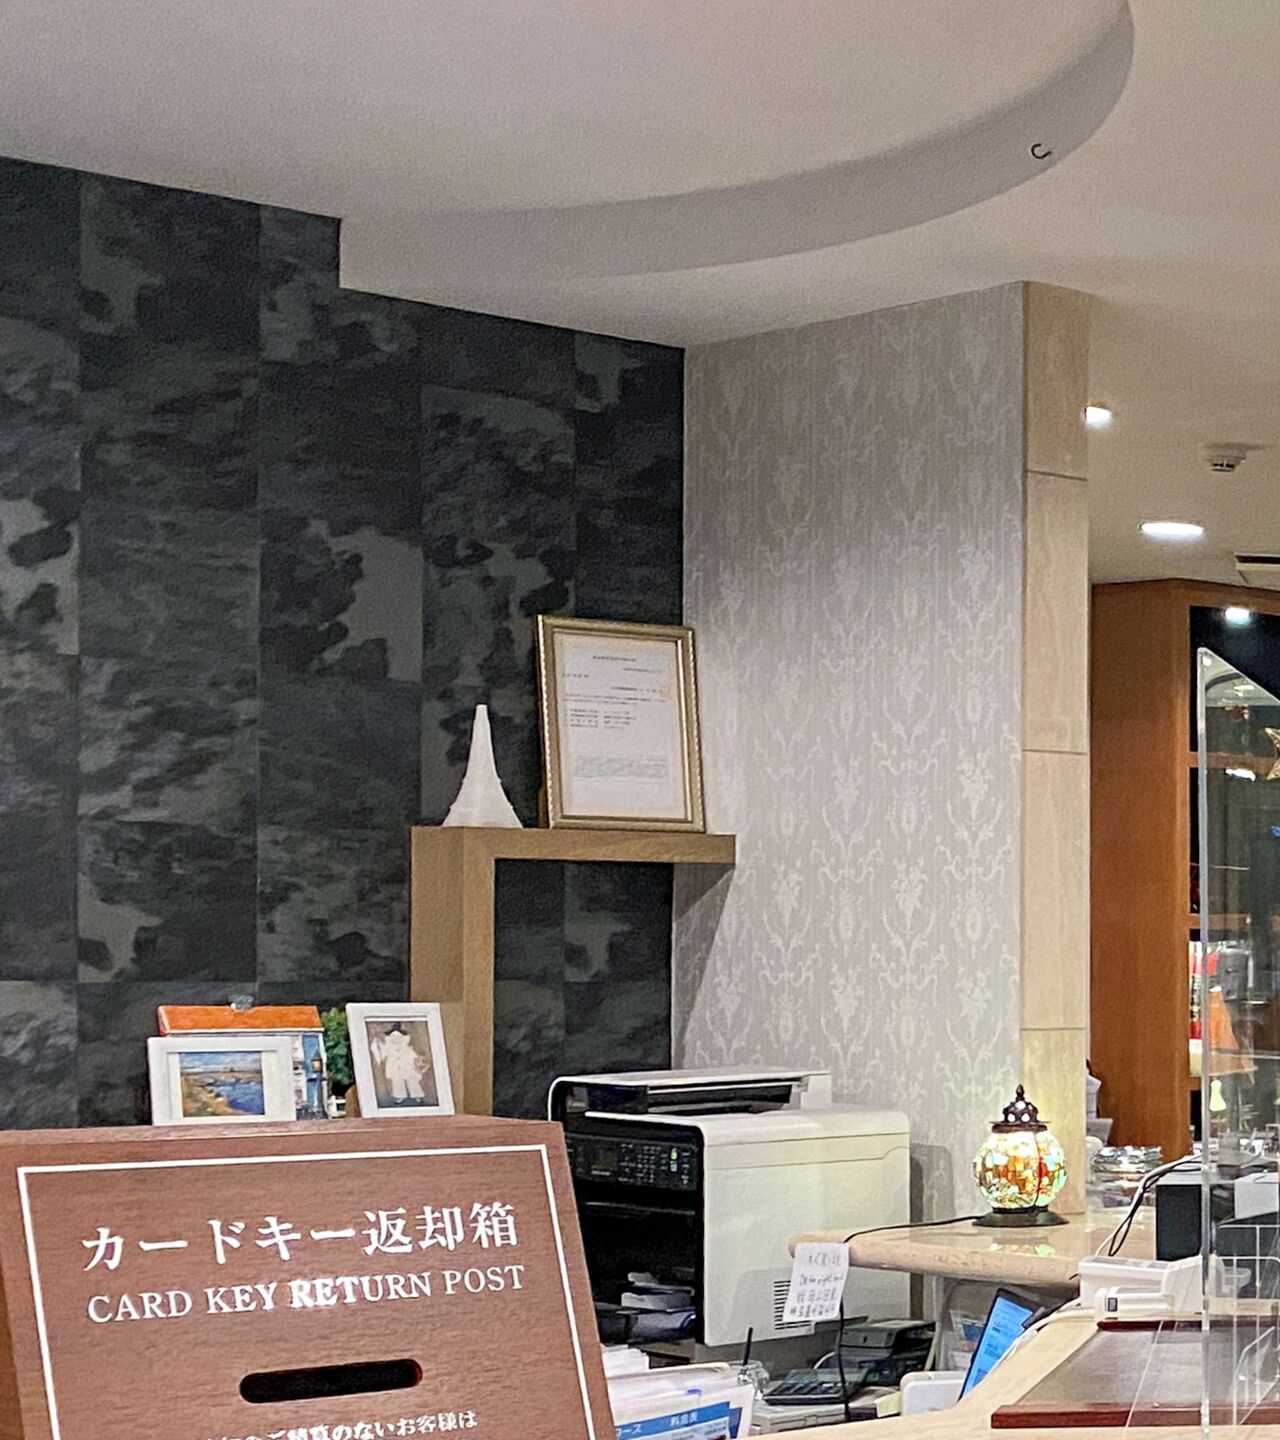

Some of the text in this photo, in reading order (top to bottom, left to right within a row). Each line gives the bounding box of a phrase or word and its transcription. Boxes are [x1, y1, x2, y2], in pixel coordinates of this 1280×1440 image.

[81, 1202, 518, 1271] カードキー返却箱
[88, 1264, 525, 1323] CARD KEY RETURN POST
